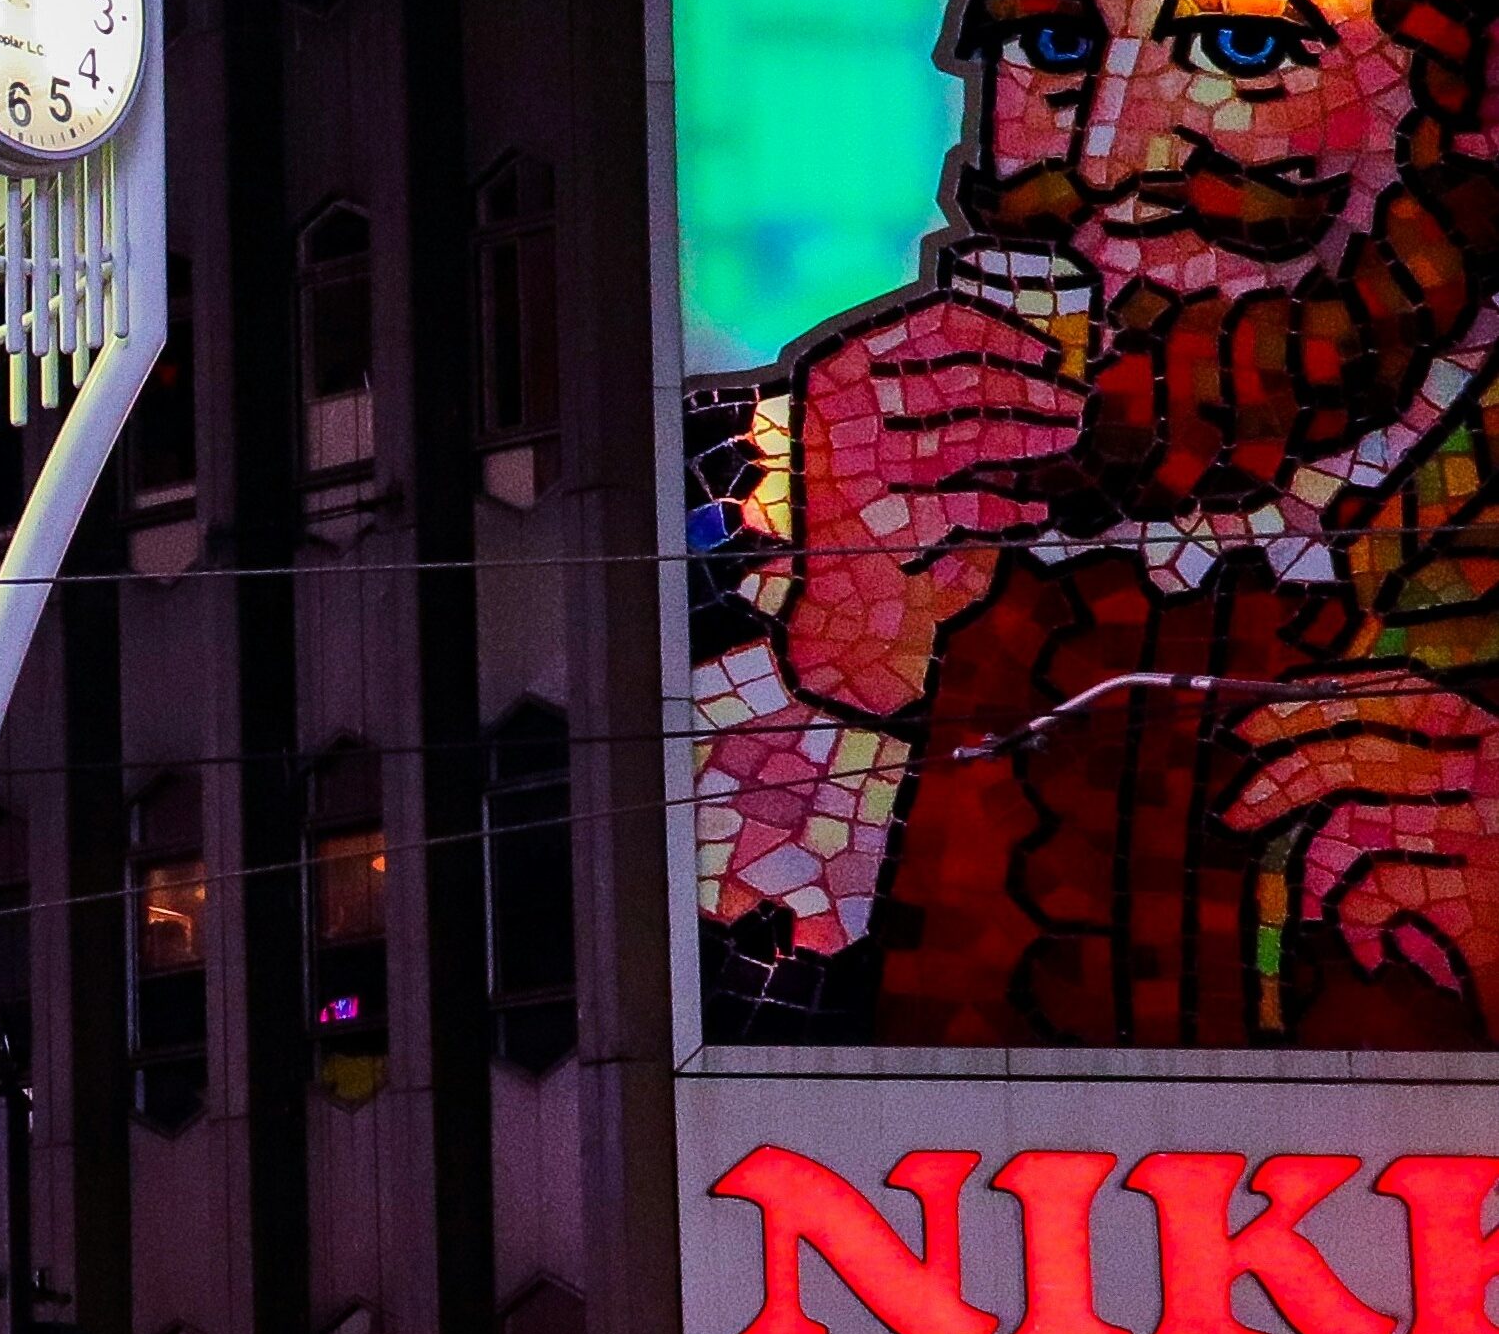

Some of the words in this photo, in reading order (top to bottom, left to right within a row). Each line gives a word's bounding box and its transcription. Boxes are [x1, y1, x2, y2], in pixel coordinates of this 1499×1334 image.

[78, 47, 99, 90] 4
[8, 82, 31, 128] 6
[49, 78, 71, 123] 5
